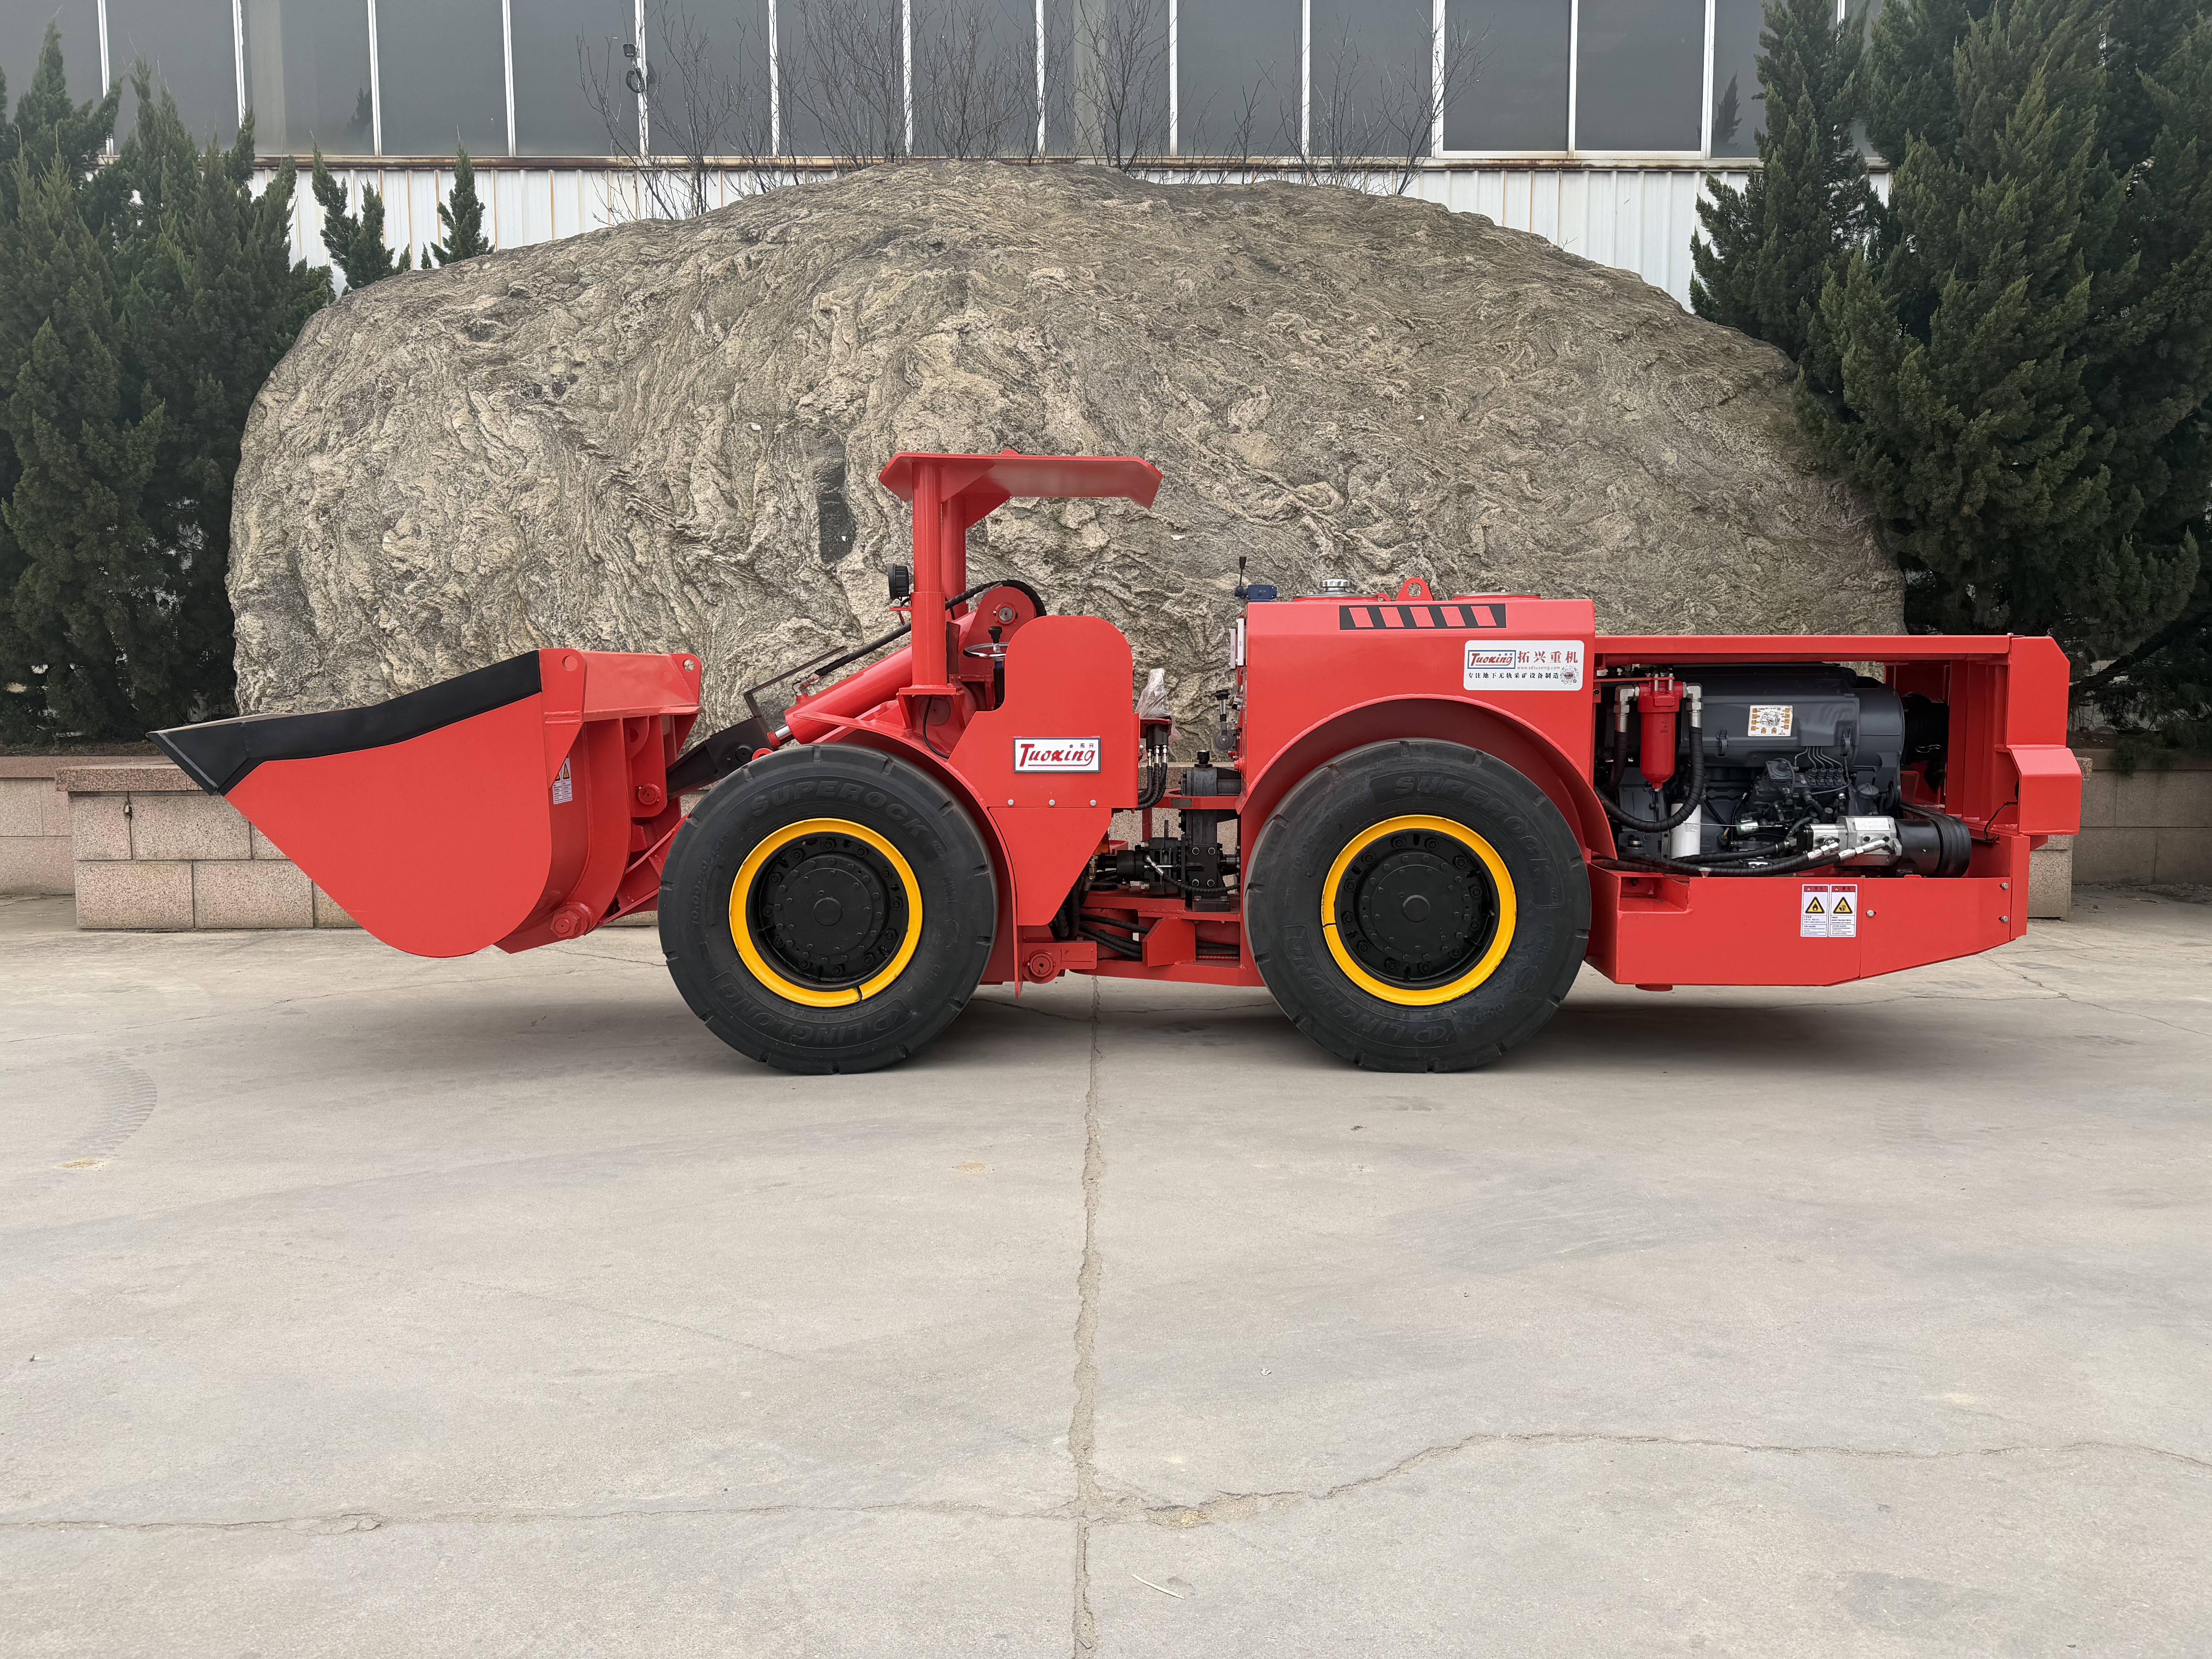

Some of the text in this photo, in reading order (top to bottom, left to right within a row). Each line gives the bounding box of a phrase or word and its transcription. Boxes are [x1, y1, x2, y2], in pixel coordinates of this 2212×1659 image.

[1471, 653, 1513, 666] Tuoxing
[1517, 651, 1578, 663] 拓兴重机
[1019, 744, 1096, 767] Tuoxing
[750, 780, 930, 839] SUPEROCK
[1394, 776, 1553, 878] SUPEROCK
[718, 983, 863, 1044] LINGLONG
[1287, 936, 1406, 1041] LINGLONG
